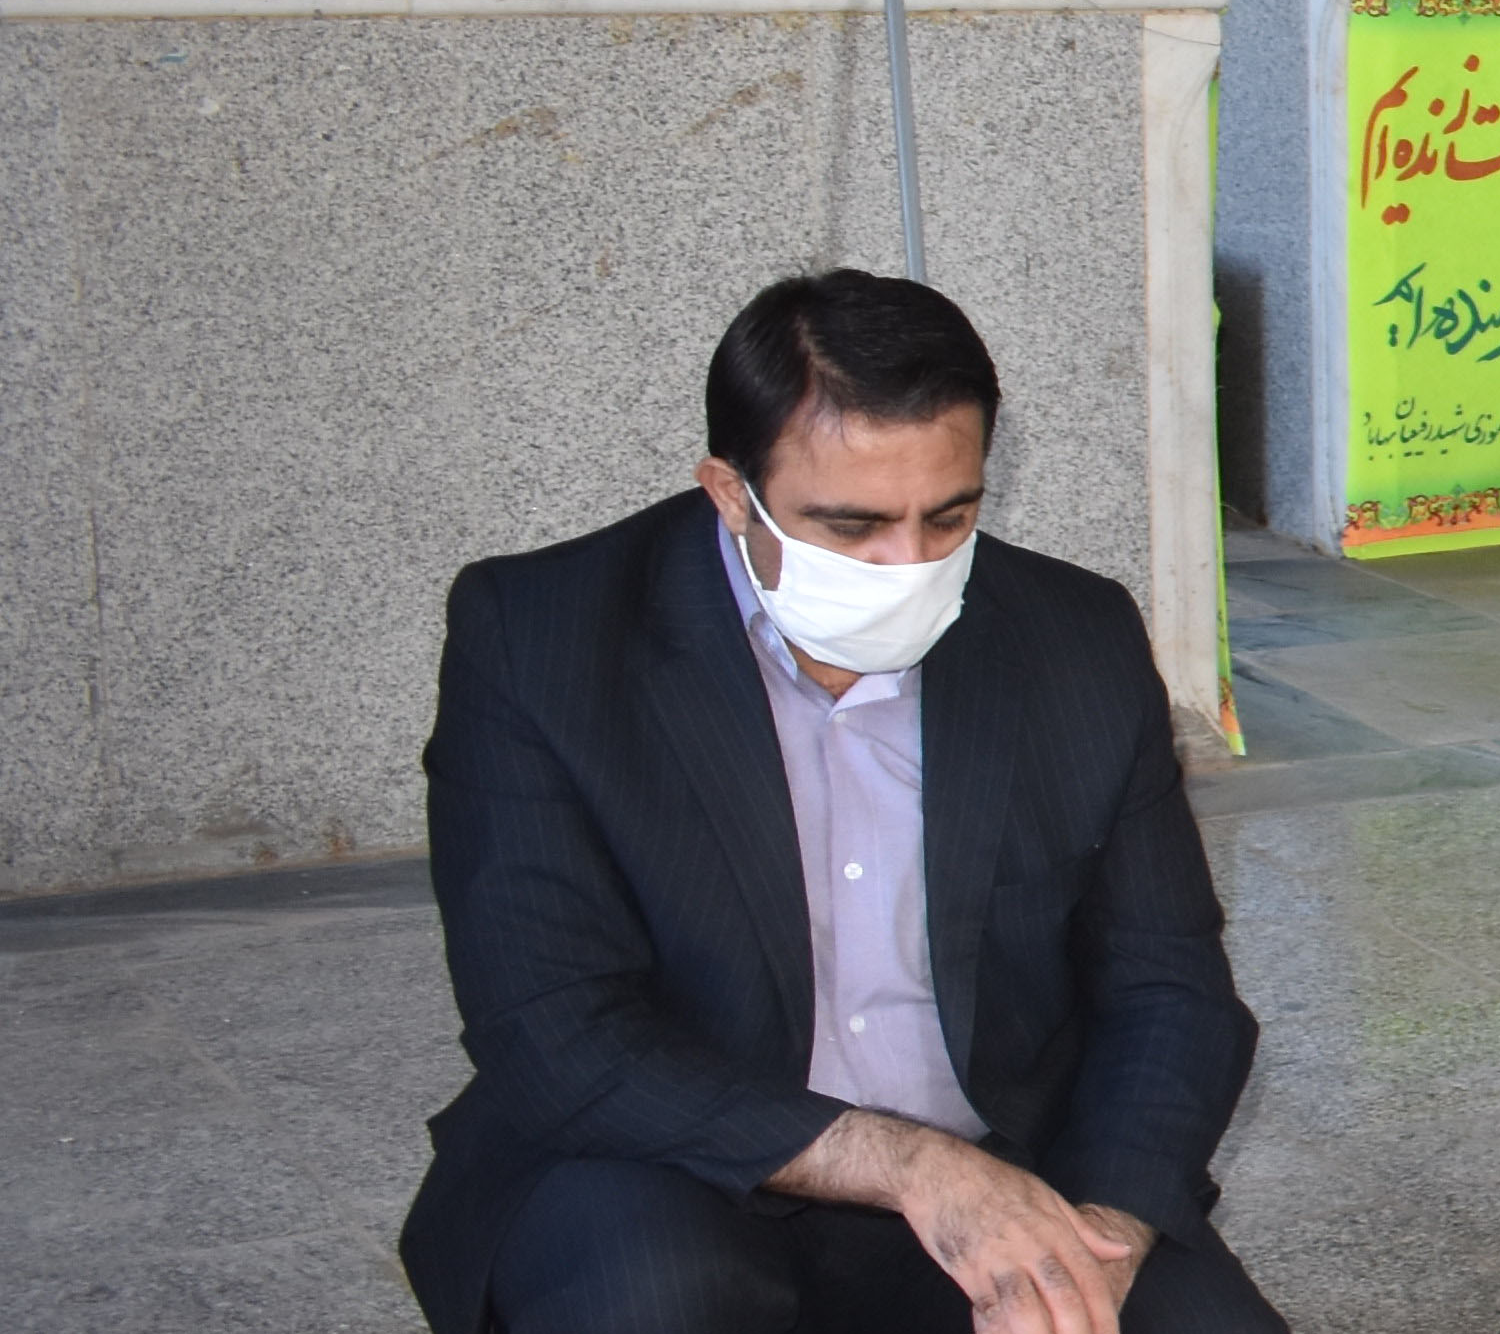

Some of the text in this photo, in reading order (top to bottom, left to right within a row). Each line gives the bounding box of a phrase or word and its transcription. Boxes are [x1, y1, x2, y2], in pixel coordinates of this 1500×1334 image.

[1361, 65, 1419, 226] ایم
[1393, 54, 1480, 182] زنده
[1371, 261, 1428, 349] ایم
[1362, 410, 1396, 462] بهاباد
[1395, 396, 1434, 457] رفیعیان
[1432, 402, 1466, 456] شهید
